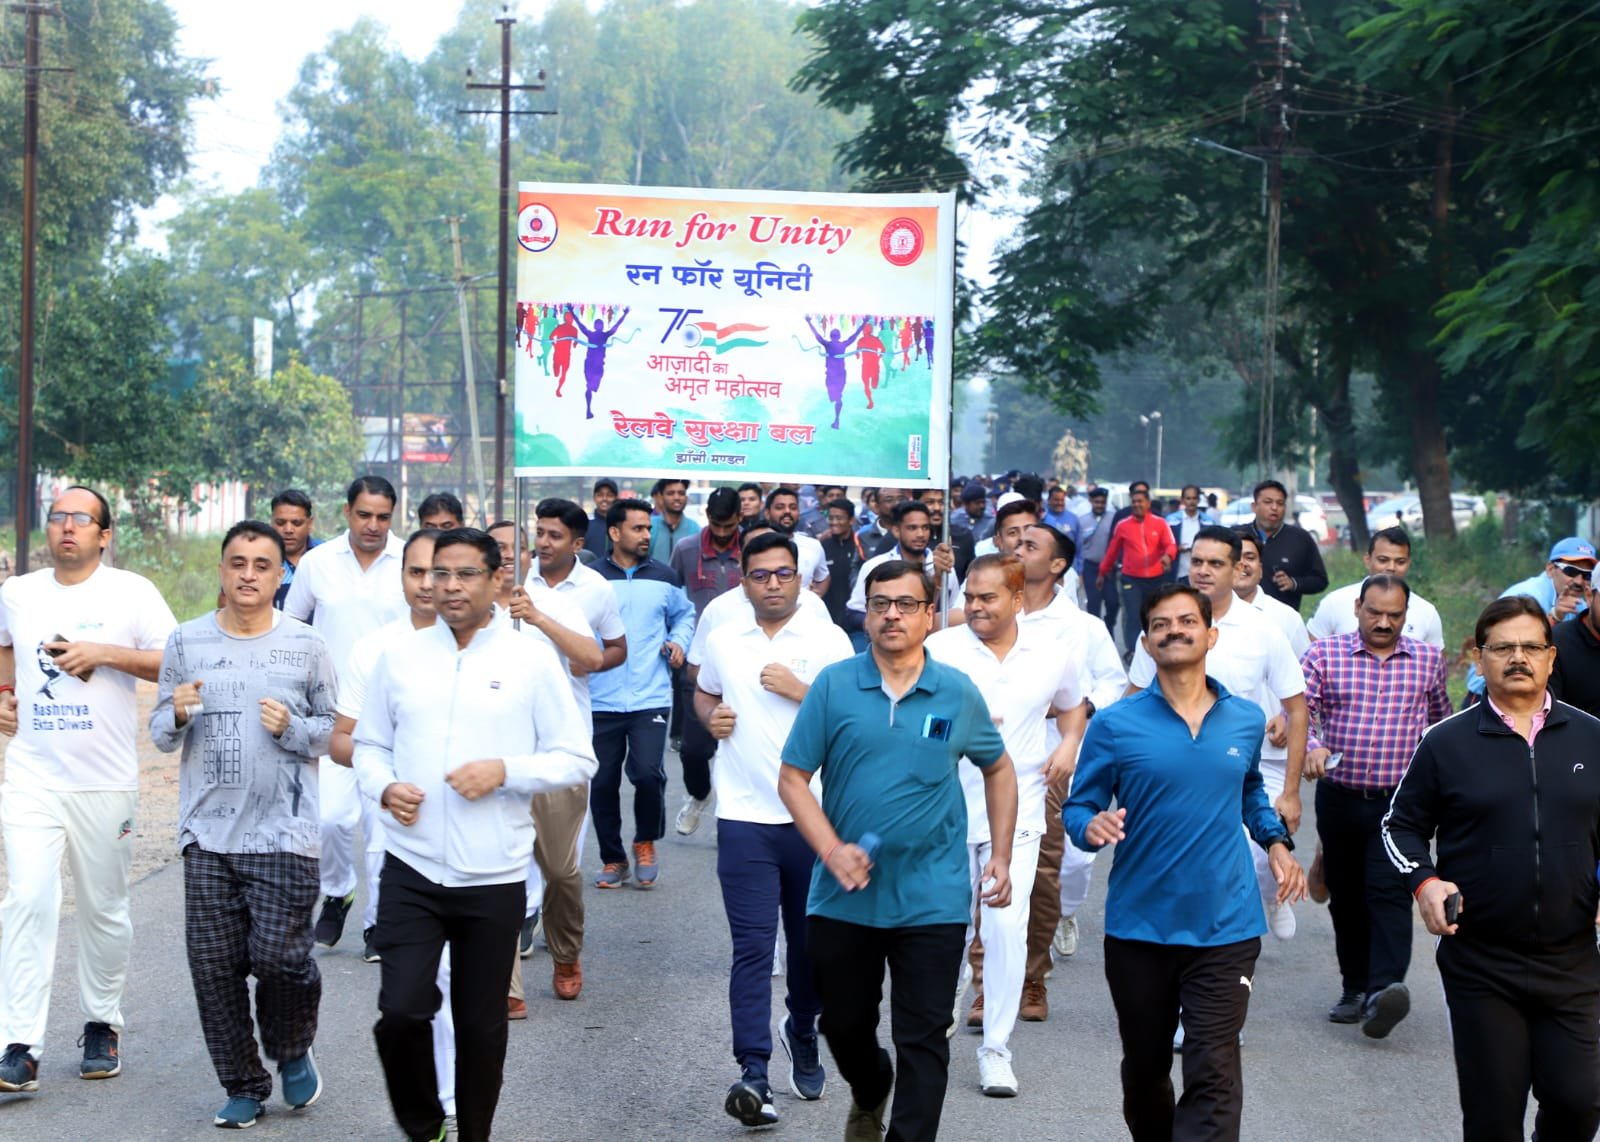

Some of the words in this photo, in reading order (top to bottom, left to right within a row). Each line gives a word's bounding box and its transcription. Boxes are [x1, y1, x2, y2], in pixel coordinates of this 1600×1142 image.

[592, 208, 674, 238] Run
[675, 212, 737, 248] for
[749, 216, 852, 255] Unity
[625, 264, 663, 285] रन
[671, 258, 724, 289] फॉर
[733, 261, 813, 298] यूनिटी
[647, 350, 712, 375] आज़ादी
[712, 363, 729, 375] का
[665, 376, 711, 401] अमृत
[715, 374, 783, 400] महोत्सव
[609, 410, 676, 439] रेलवे
[684, 420, 760, 447] सुरक्षा
[769, 424, 816, 445] बल
[710, 454, 746, 465] मण्डल
[268, 649, 310, 668] STREET
[32, 703, 90, 718] Rashtriya
[32, 718, 55, 731] Ekta
[57, 718, 94, 731] Diwas
[203, 712, 241, 738] BLACK
